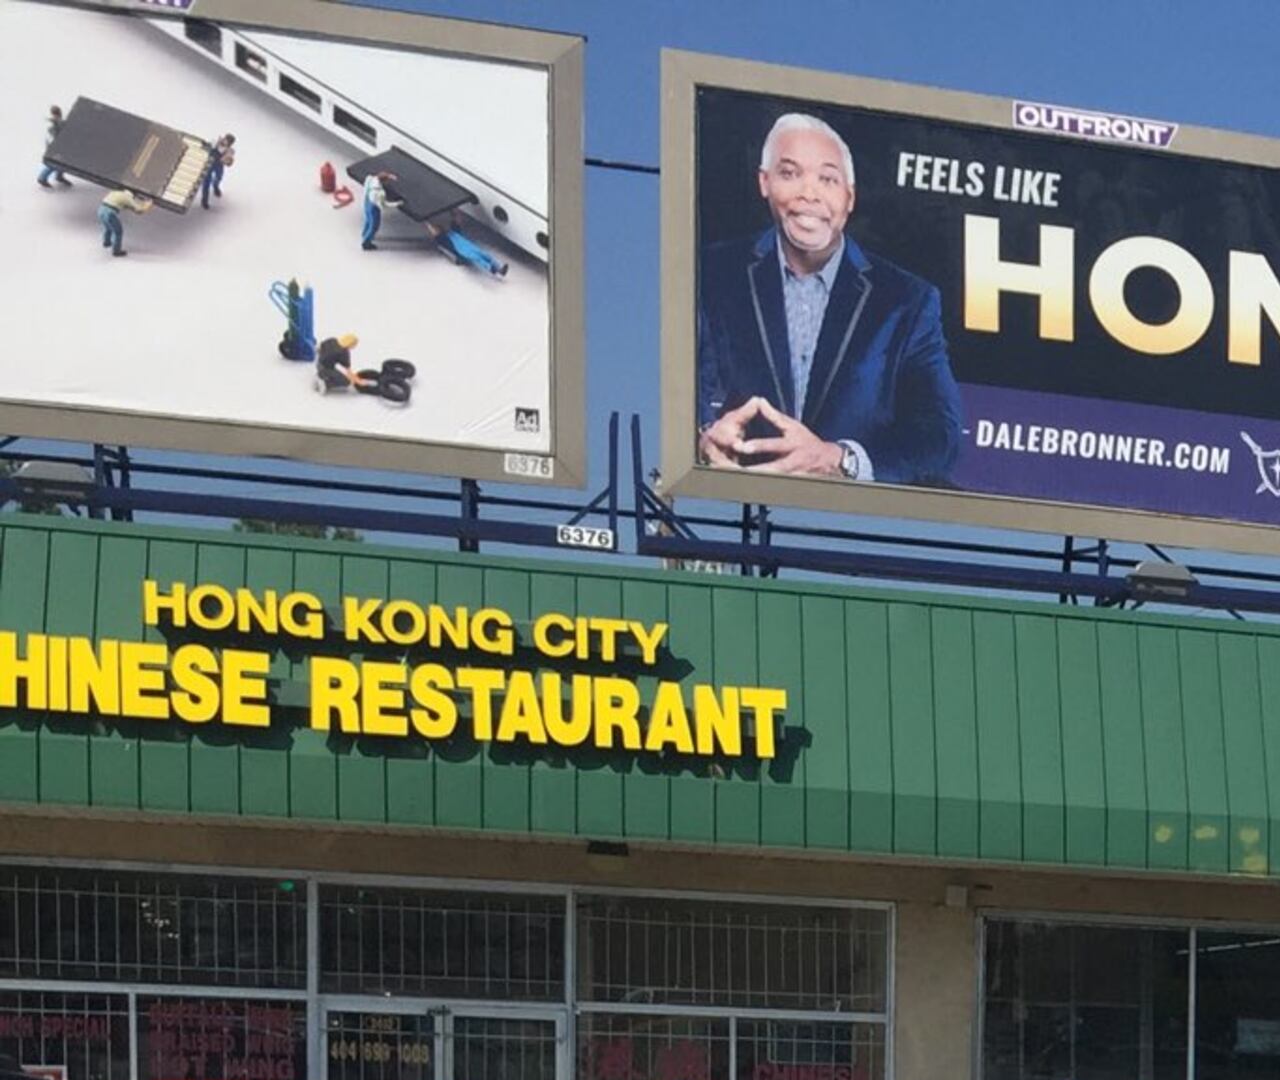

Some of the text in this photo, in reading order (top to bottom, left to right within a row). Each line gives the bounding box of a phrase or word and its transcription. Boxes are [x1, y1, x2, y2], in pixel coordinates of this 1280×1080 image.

[1019, 106, 1169, 144] OUTFRONT
[897, 151, 1061, 206] FEELS LIKE
[507, 455, 550, 475] 6376
[975, 418, 1230, 474] DALEBRONNER.COM
[560, 527, 610, 546] 6376
[144, 580, 668, 665] HONG KONG CITY
[0, 631, 788, 759] HINESE RESTAURANT
[227, 1056, 294, 1080] WING
